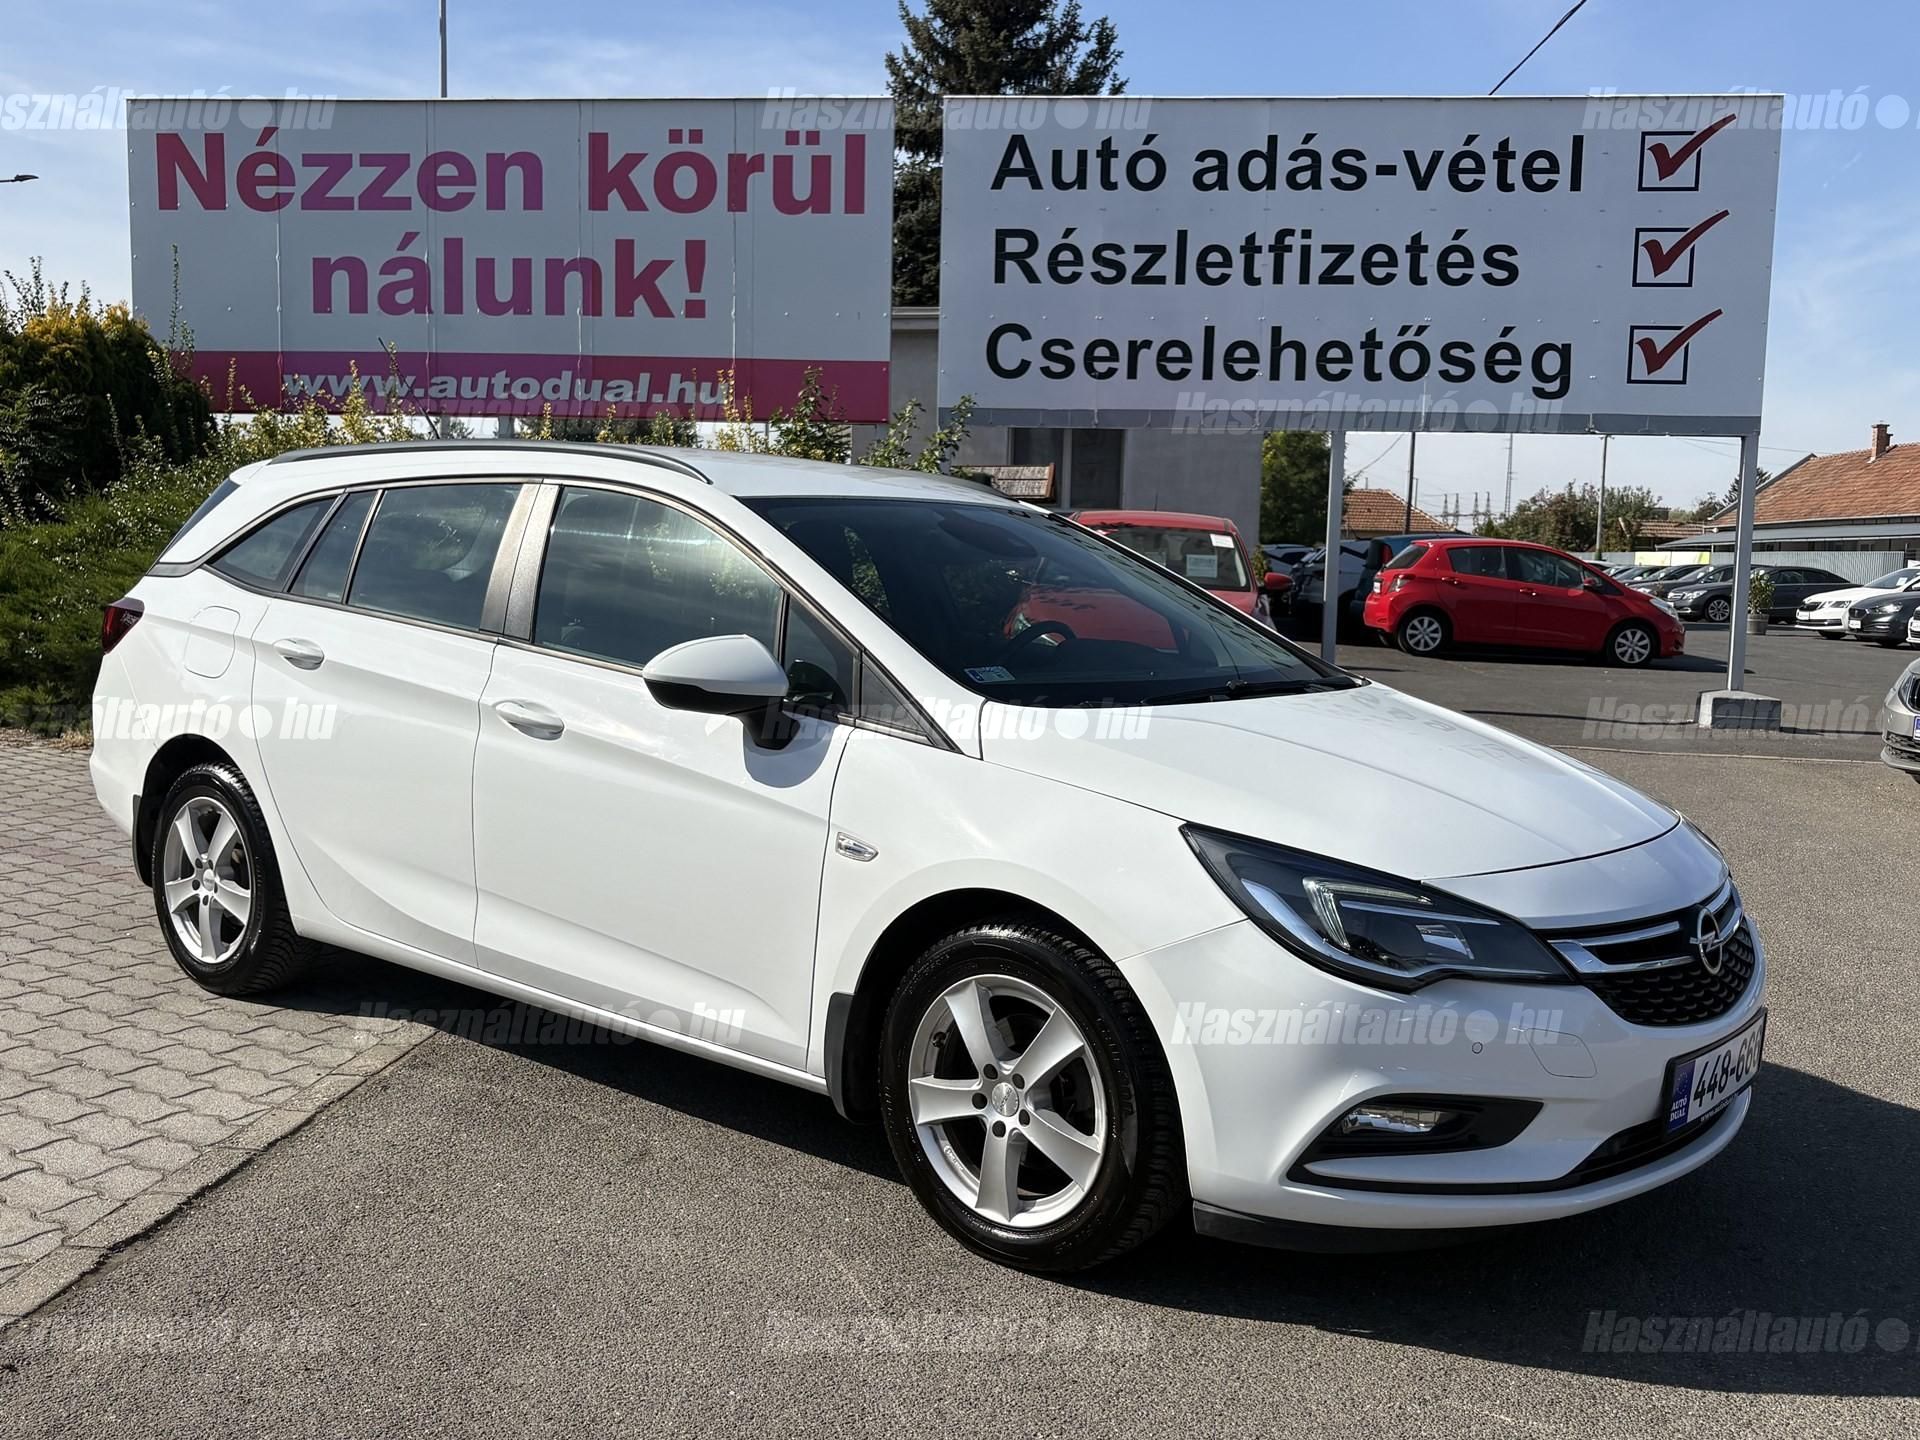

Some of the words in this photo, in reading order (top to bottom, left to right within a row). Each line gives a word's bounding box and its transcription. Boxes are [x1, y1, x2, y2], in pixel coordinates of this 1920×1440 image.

[157, 127, 543, 212] Nézzen
[589, 129, 866, 215] körül
[991, 133, 1167, 192] Autó
[1192, 133, 1584, 193] adás-vétel
[312, 232, 708, 318] nálunk!
[994, 227, 1519, 288] Részletfizetés
[283, 371, 731, 405] www.autodual.hu
[986, 323, 1572, 399] Cserelehetőség
